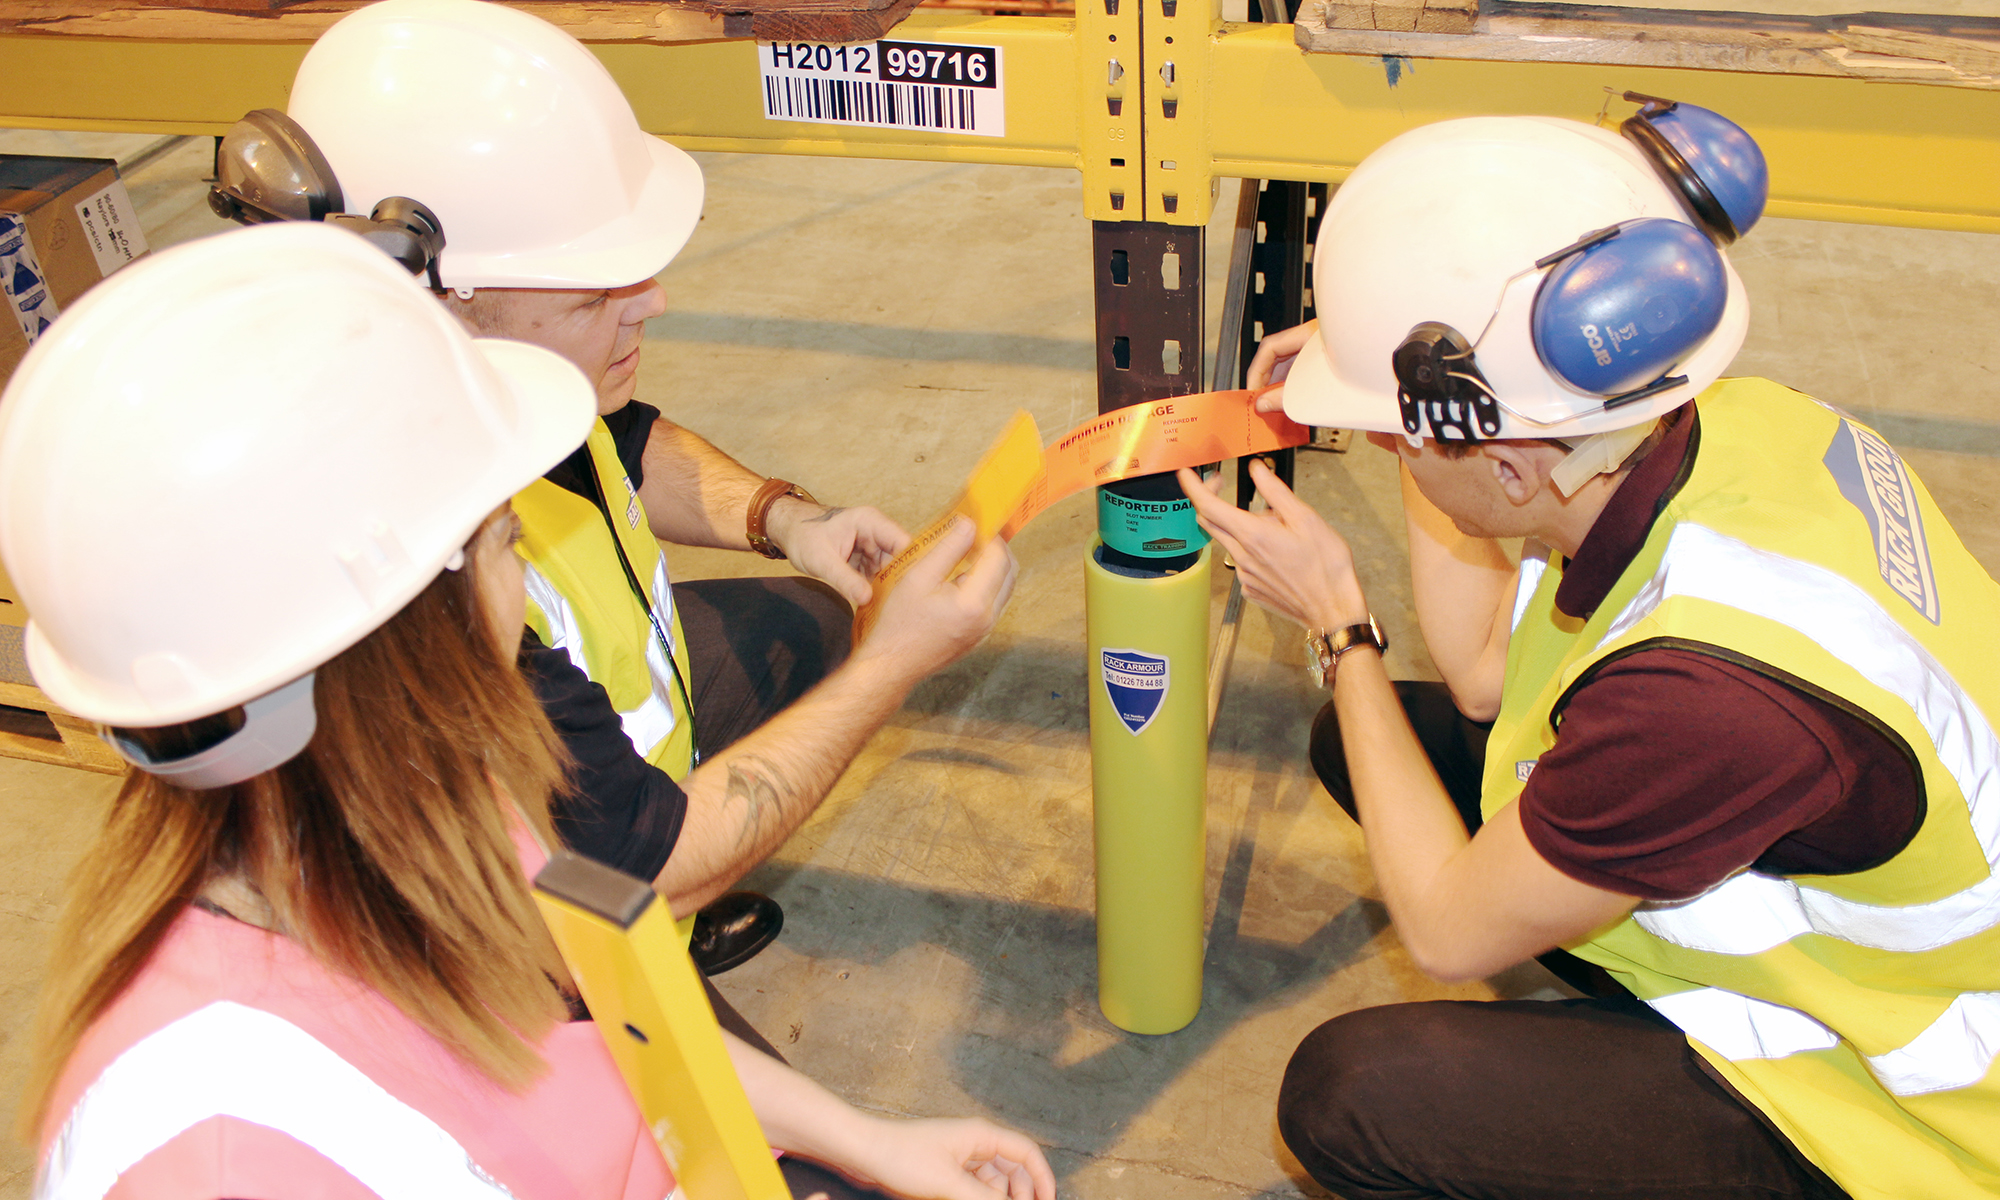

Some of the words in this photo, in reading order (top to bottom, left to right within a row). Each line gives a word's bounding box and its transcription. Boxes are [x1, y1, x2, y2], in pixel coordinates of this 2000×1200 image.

[771, 41, 872, 74] H2012
[886, 48, 987, 82] 99716
[1582, 324, 1612, 366] arco
[1105, 493, 1169, 513] REPORTED
[879, 543, 921, 584] REPORTED
[923, 513, 960, 547] DAMAGE
[1882, 505, 1923, 609] RACK
[1104, 657, 1125, 669] RACK
[1126, 663, 1164, 672] ARMOUR
[1116, 674, 1136, 686] 01226
[1136, 678, 1145, 687] 78
[1145, 679, 1154, 687] 44
[1154, 678, 1164, 687] 88
